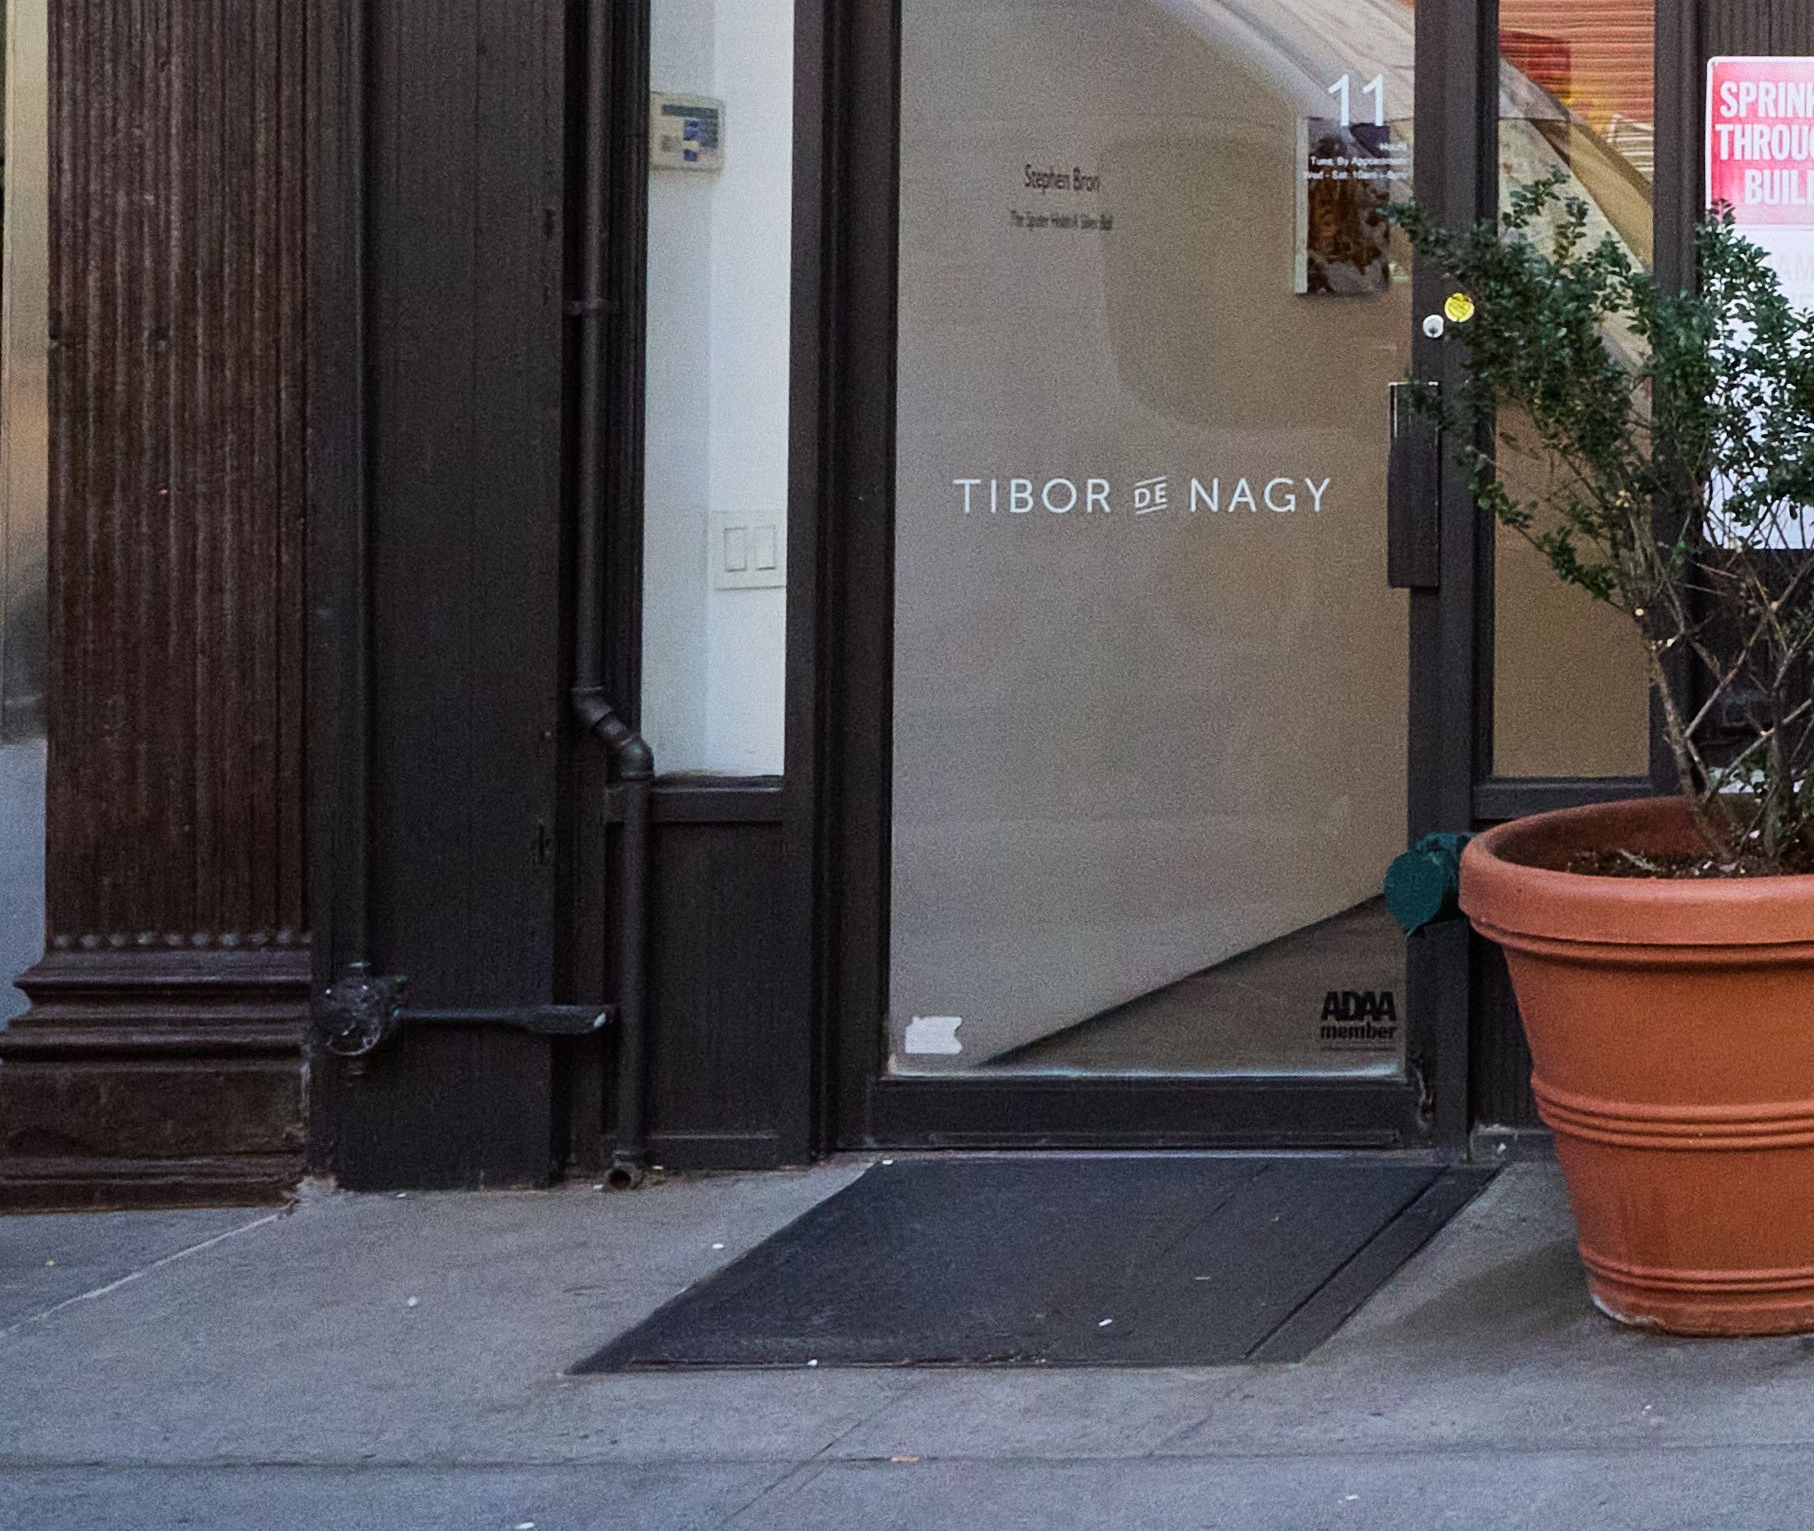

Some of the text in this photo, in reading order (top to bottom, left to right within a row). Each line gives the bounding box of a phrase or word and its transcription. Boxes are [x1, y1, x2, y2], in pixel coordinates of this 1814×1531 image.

[1326, 73, 1384, 127] 11
[953, 476, 1332, 515] TIBOR DE NAGY
[1320, 990, 1398, 1023] ADAA
[1319, 1021, 1398, 1040] member
